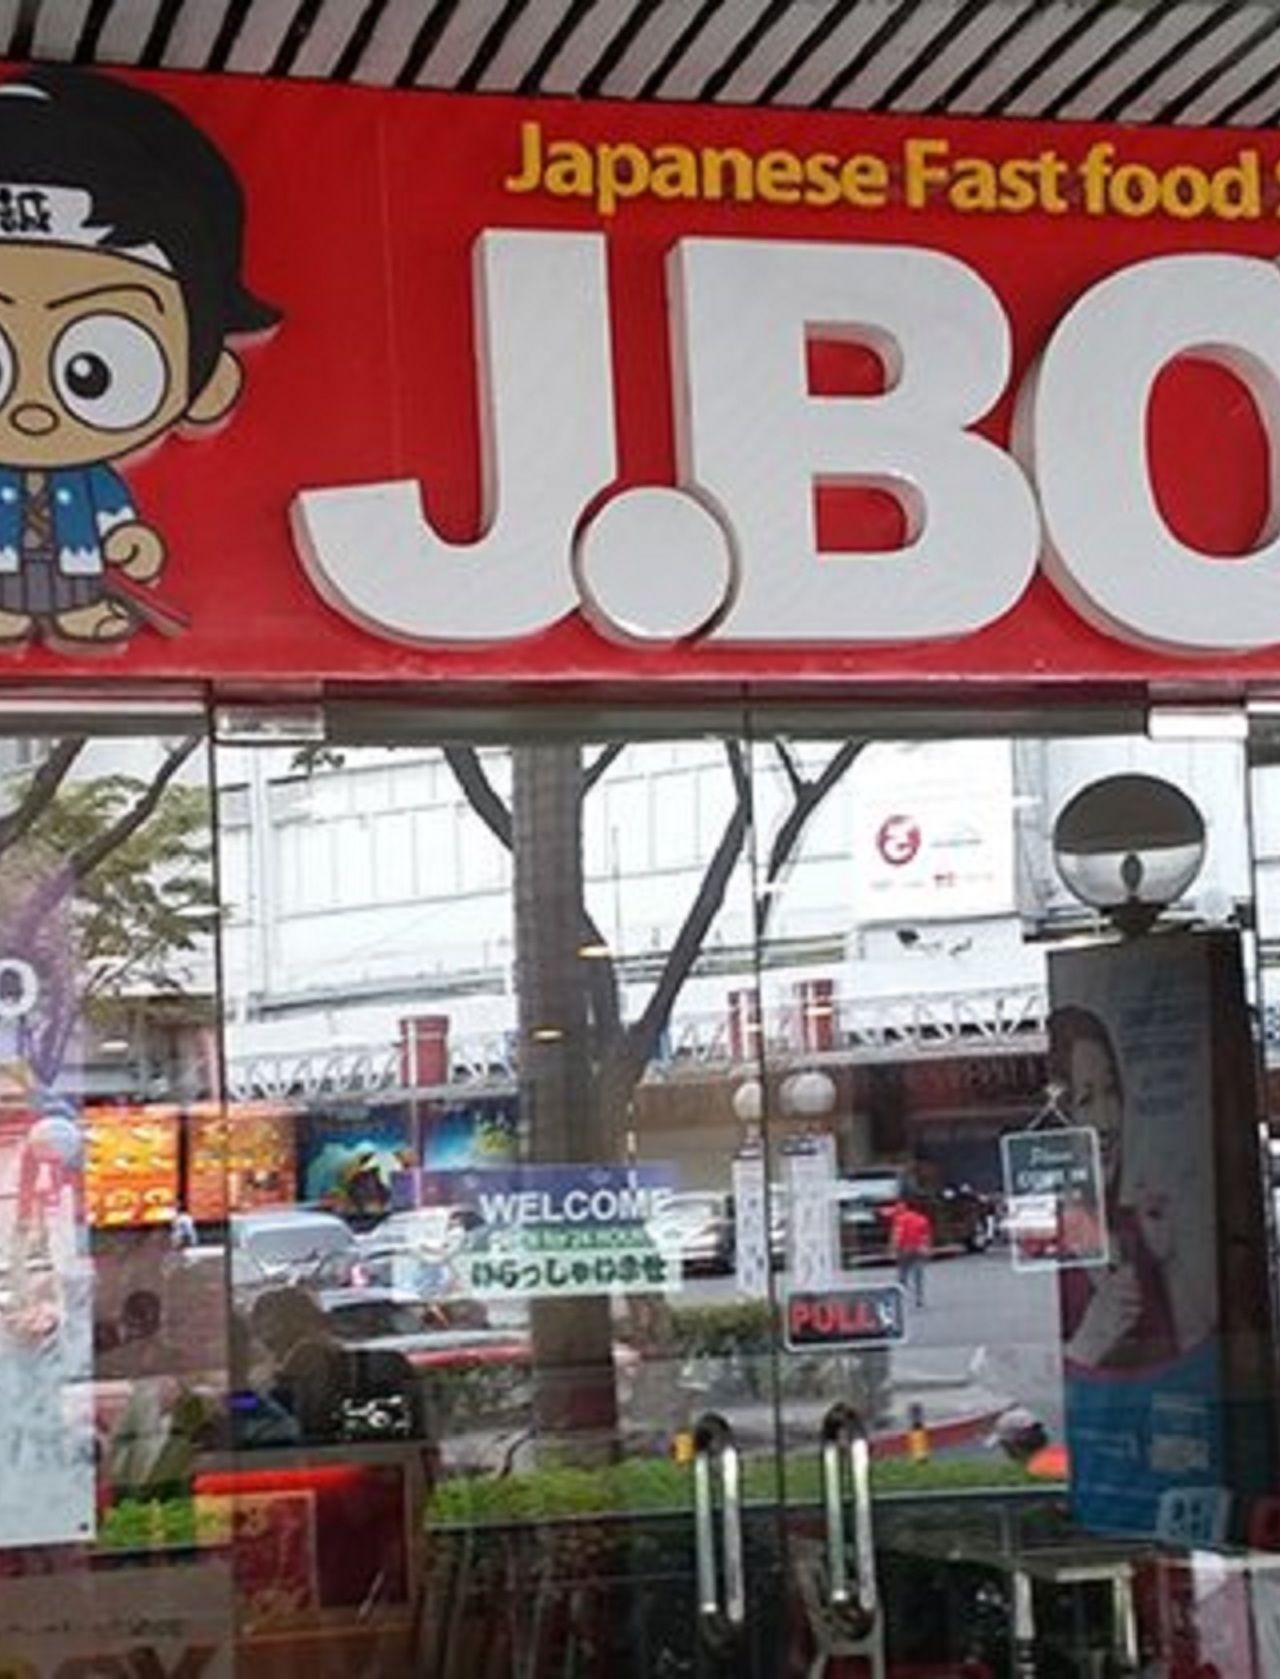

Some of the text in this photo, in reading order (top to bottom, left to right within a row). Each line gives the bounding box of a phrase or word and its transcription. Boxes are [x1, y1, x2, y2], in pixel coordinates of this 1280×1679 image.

[505, 121, 890, 217] Japanese
[904, 138, 1070, 213] Fast
[1079, 143, 1261, 218] food
[477, 1186, 673, 1224] WELCOME
[791, 1298, 879, 1335] PULL
